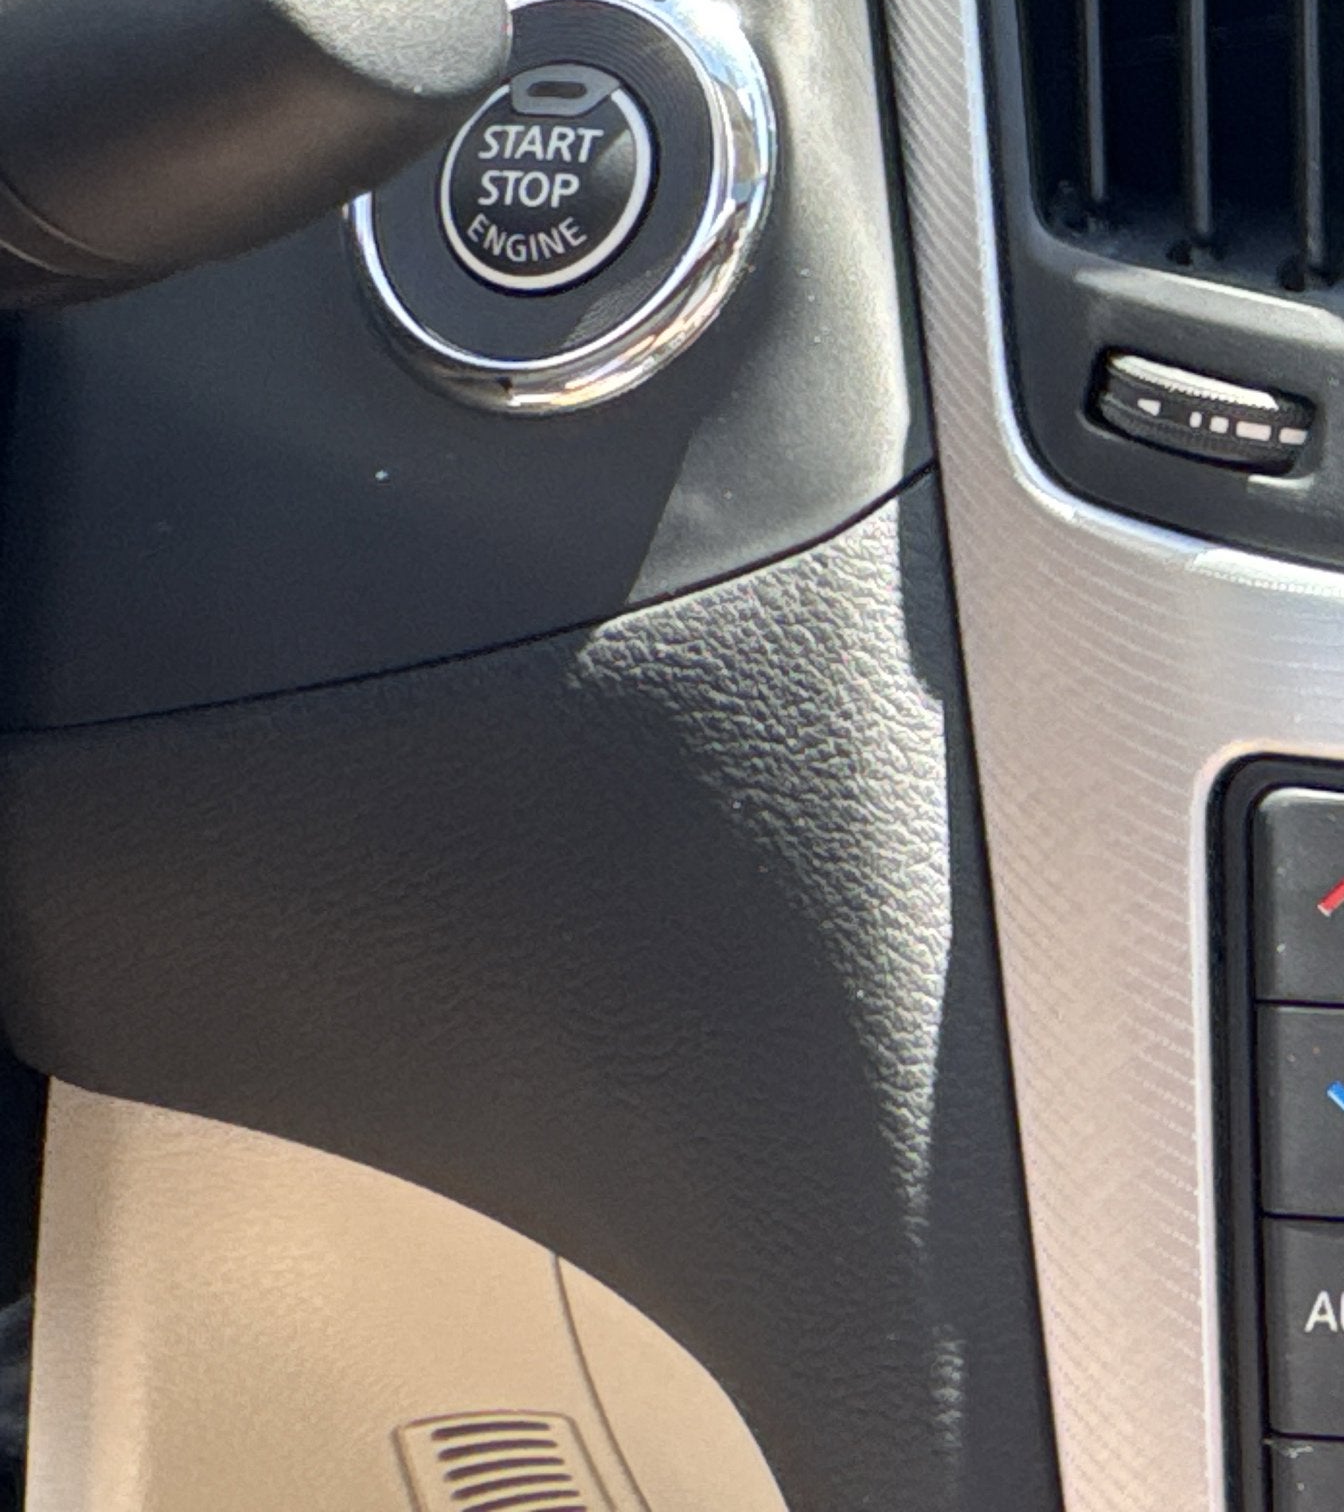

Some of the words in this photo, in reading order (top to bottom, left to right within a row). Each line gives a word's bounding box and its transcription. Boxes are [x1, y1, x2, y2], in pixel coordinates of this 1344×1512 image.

[478, 125, 604, 162] START
[478, 171, 580, 208] STOP
[467, 213, 588, 263] ENGINE
